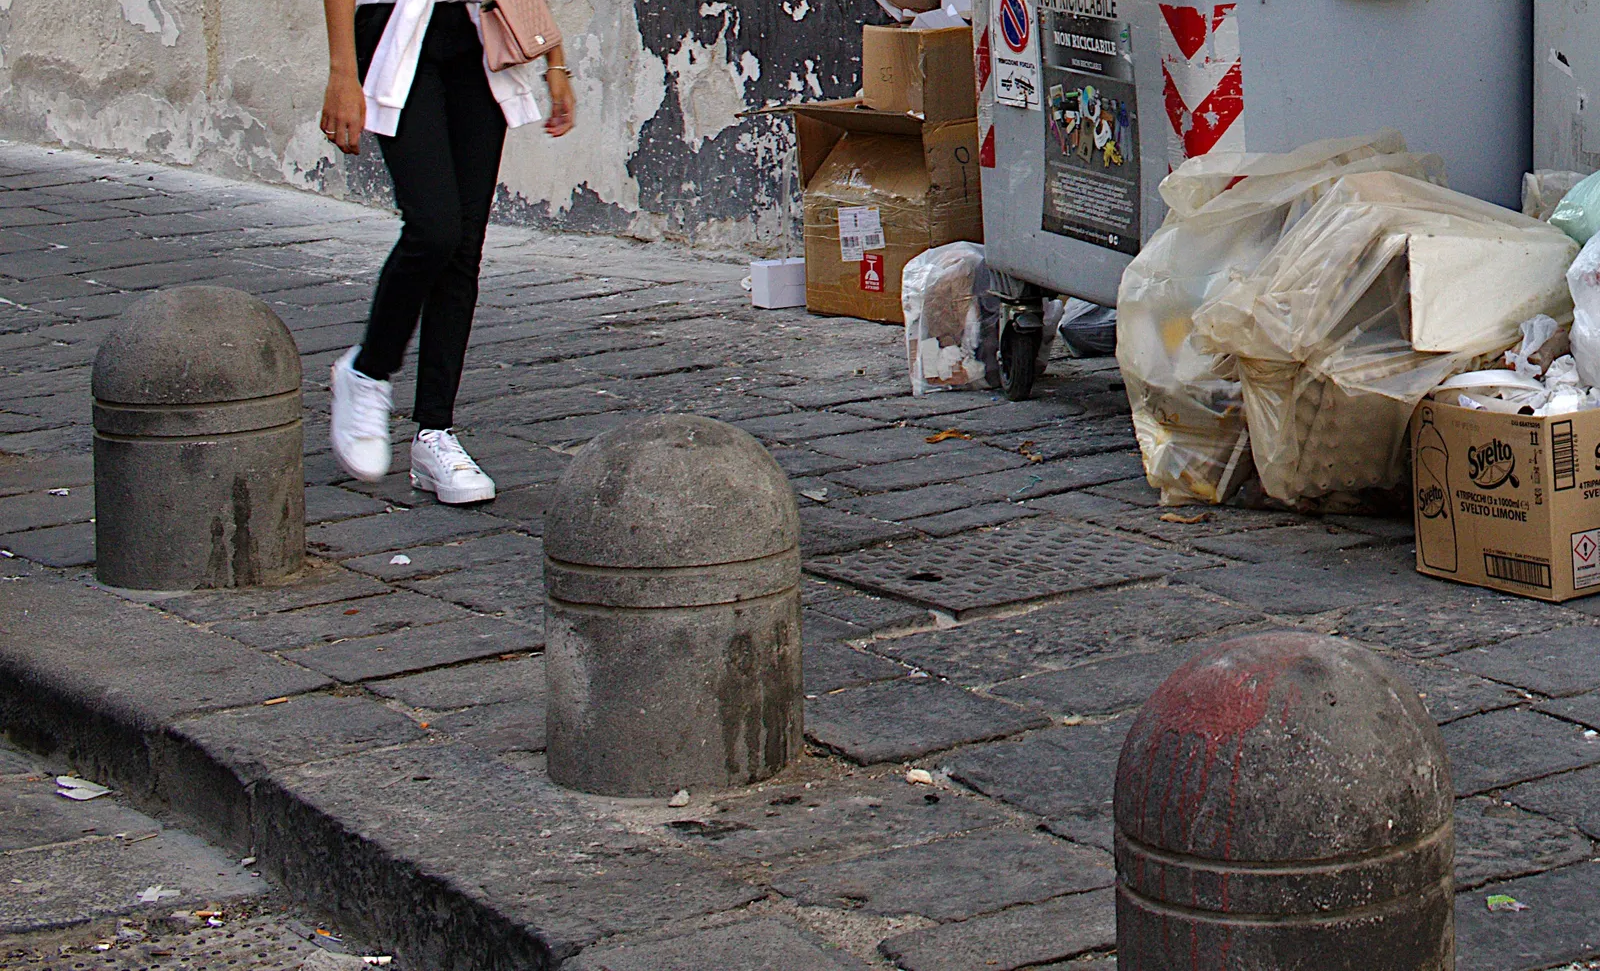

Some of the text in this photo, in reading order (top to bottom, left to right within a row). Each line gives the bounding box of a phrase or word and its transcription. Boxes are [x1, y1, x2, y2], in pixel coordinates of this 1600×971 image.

[1054, 31, 1116, 55] NON RICICLABILE
[1468, 438, 1512, 479] Svelto
[1419, 484, 1443, 512] Svelto
[1456, 490, 1519, 509] 4 TRIPACCHI 1000ml
[1461, 502, 1527, 522] SVELTO LIMONE
